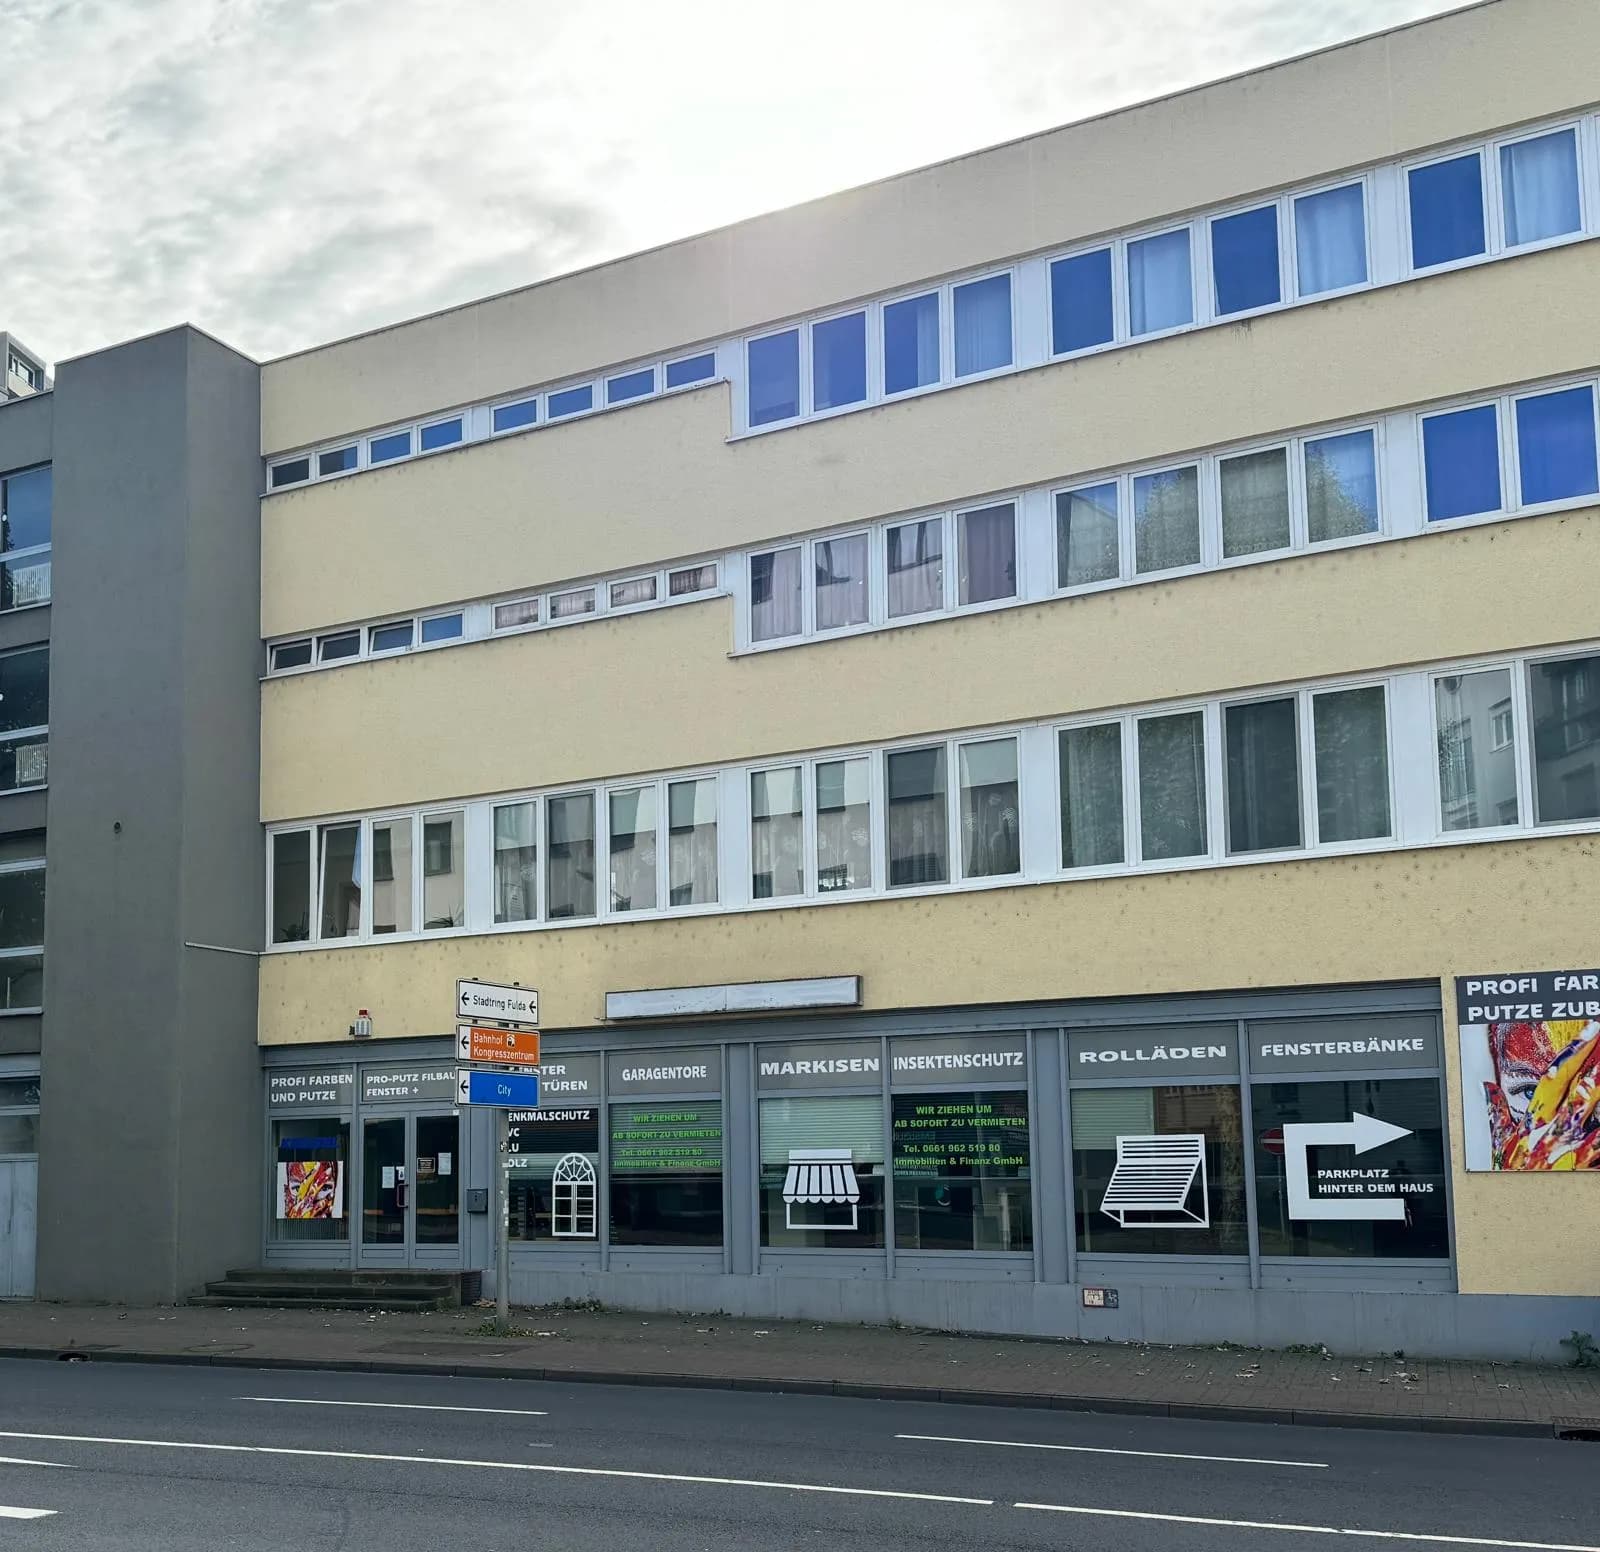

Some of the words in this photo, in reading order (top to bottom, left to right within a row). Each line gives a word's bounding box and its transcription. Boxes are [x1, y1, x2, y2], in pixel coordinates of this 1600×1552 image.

[1466, 978, 1538, 996] PROFI
[1553, 975, 1600, 991] FAR
[473, 995, 505, 1010] Stadtring
[507, 1000, 526, 1011] Fulda
[1468, 1003, 1543, 1021] PUTZE
[1551, 1001, 1600, 1017] ZUB
[473, 1033, 503, 1044] Bahnhof
[1261, 1037, 1424, 1056] FENSTERBÄNKE
[473, 1046, 534, 1060] Kongresszentrum
[1079, 1045, 1227, 1064] ROLLÄDEN
[760, 1058, 879, 1075] MARKISEN
[893, 1052, 1024, 1070] INSEKTENSCHUTZ
[622, 1065, 707, 1081] GARAGENTORE
[271, 1076, 306, 1087] PROFI
[309, 1074, 353, 1085] FARBEN
[366, 1074, 419, 1084] PRO-PUTZ
[497, 1084, 511, 1096] City
[541, 1079, 588, 1091] TÜREN
[271, 1092, 296, 1102] UND
[299, 1090, 336, 1101] PUTZE
[366, 1087, 408, 1096] FENSTER
[915, 1106, 935, 1114] WIR
[937, 1105, 973, 1114] ZIEHEN
[976, 1105, 992, 1113] UM
[508, 1110, 590, 1121] ENKMALSCHUTZ
[633, 1114, 649, 1122] WIR
[651, 1113, 681, 1121] ZIEHEN
[684, 1113, 697, 1121] UM
[894, 1120, 908, 1128] AB
[910, 1119, 949, 1127] SOFORT
[967, 1118, 1026, 1126] VERMIETEN
[508, 1128, 520, 1136] VC
[922, 1144, 945, 1152] 0661
[508, 1158, 528, 1168] OLZ
[895, 1157, 946, 1165] Immobilien
[949, 1157, 957, 1165] &
[959, 1157, 991, 1165] Finanz
[993, 1157, 1023, 1165] GmbH
[1317, 1169, 1390, 1178] PARKPLATZ
[1318, 1184, 1363, 1193] HINTER
[1367, 1183, 1396, 1193] DEM
[1400, 1183, 1434, 1193] HAUS
